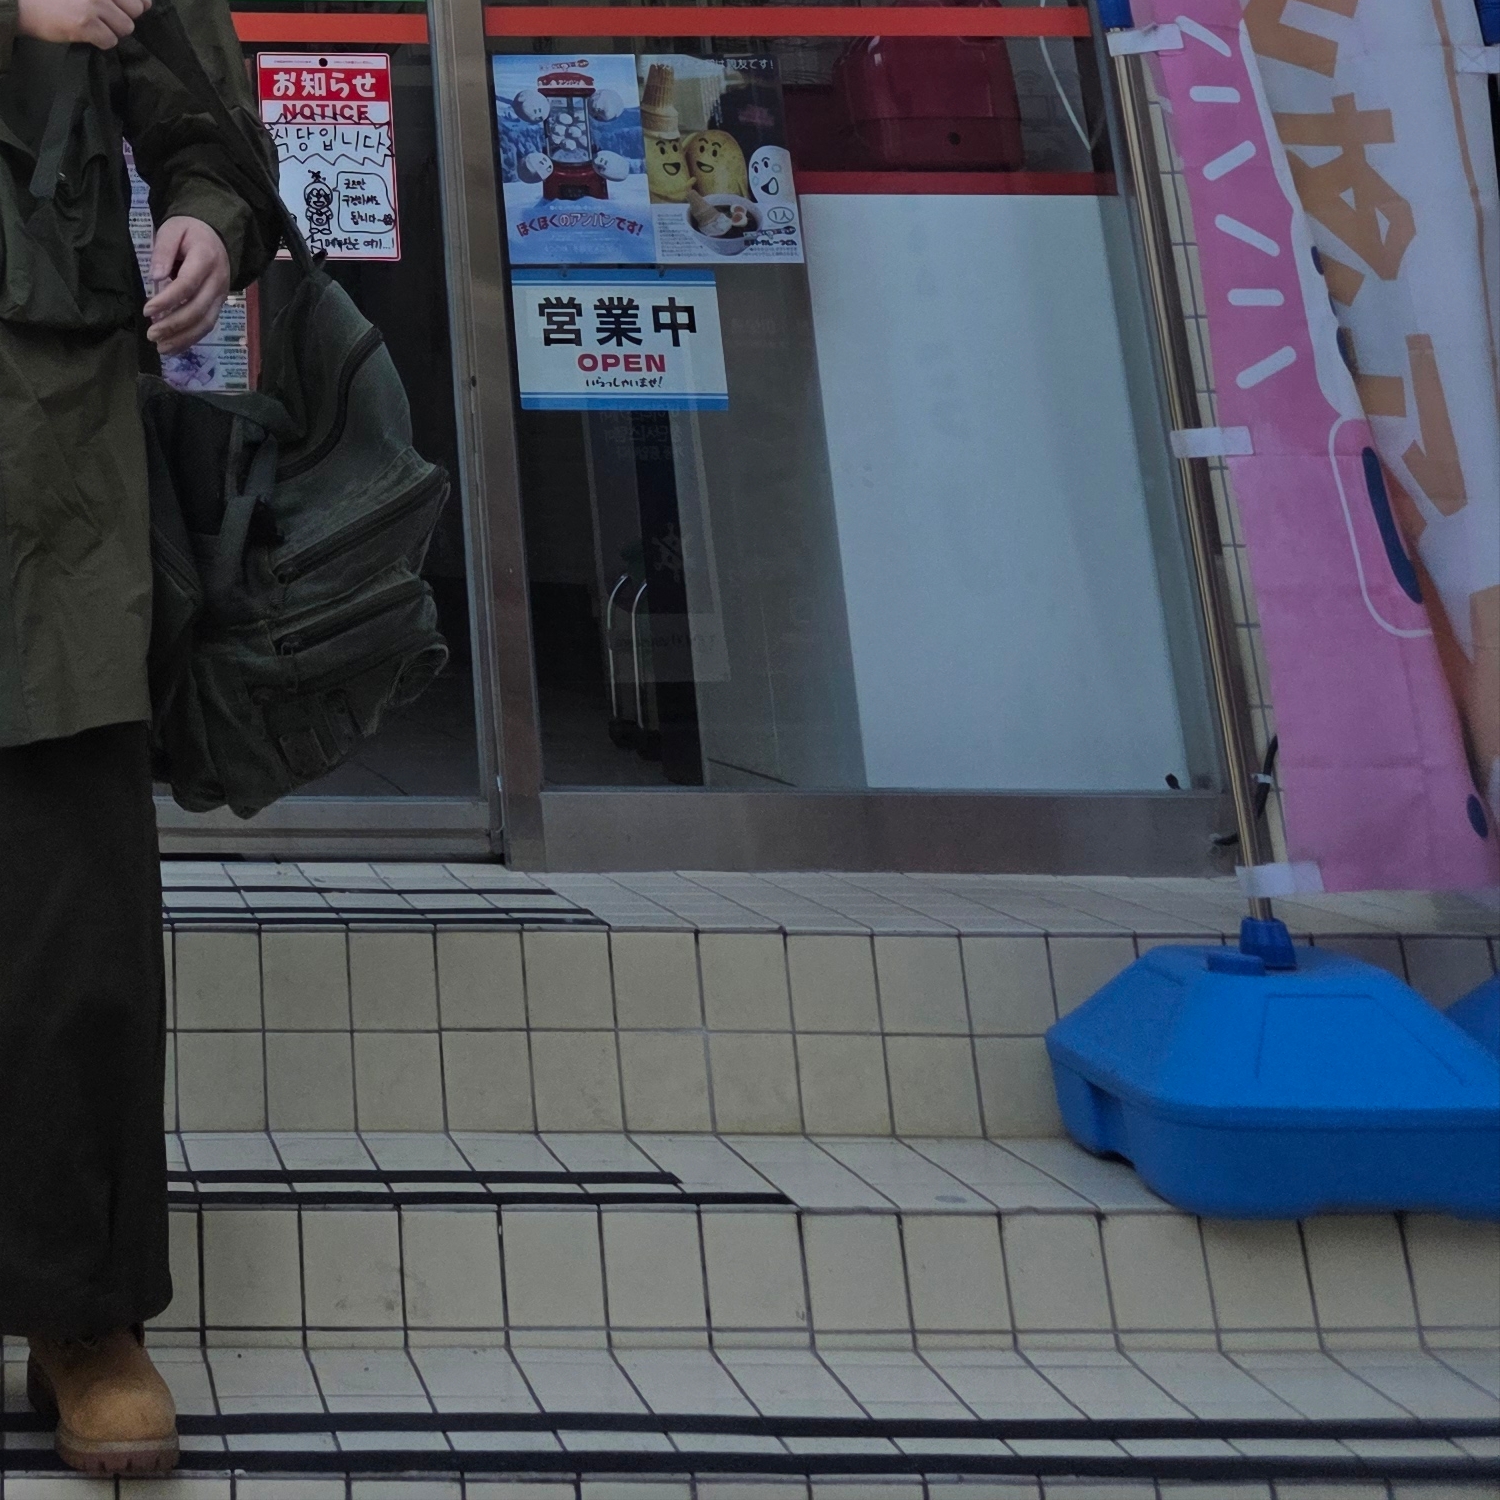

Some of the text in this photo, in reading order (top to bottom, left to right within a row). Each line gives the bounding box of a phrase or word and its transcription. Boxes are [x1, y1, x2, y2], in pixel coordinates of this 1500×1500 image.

[272, 70, 377, 99] お知らせ
[281, 103, 369, 122] NOTICE
[274, 124, 386, 154] 식당입니다
[515, 211, 645, 238] ほくほくのアンパンです!
[537, 295, 698, 349] 営業中
[577, 353, 667, 373] OPEN
[585, 375, 664, 389] いらっしゃいませ!
